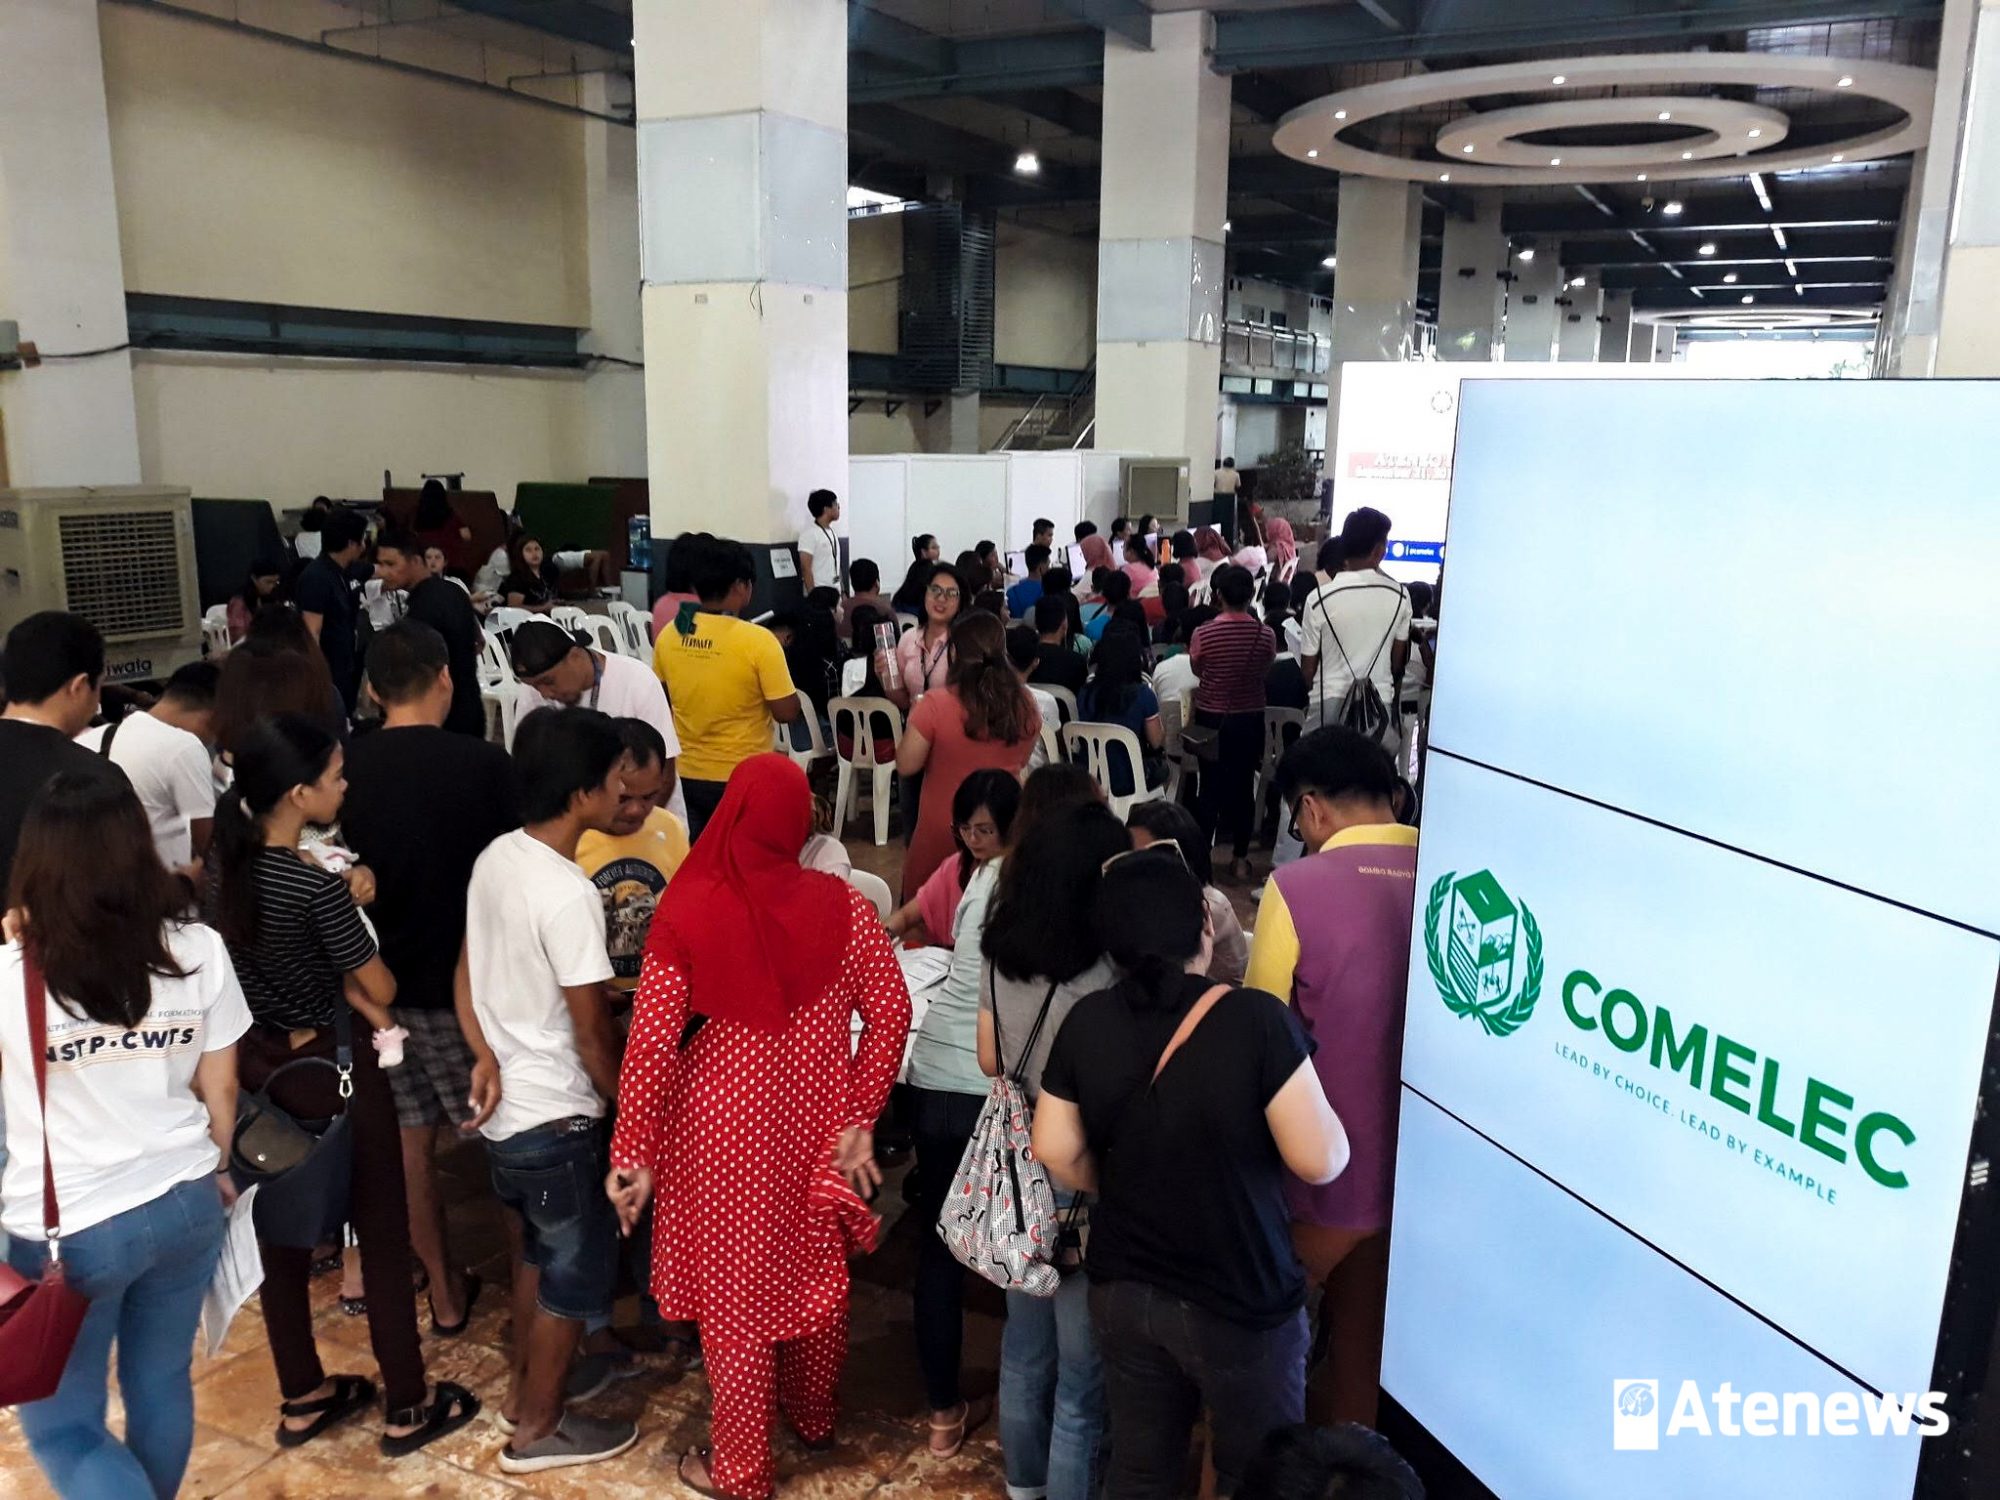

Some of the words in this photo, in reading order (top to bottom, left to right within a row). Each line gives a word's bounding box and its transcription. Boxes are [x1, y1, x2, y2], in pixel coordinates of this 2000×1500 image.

[1555, 1042, 1588, 1069] LEAD
[1593, 1062, 1610, 1080] BY
[1681, 1109, 1720, 1140] LEAD
[1727, 1135, 1747, 1154] BY
[1754, 1149, 1837, 1204] EXAMPLE
[1562, 969, 1916, 1189] COMELEC
